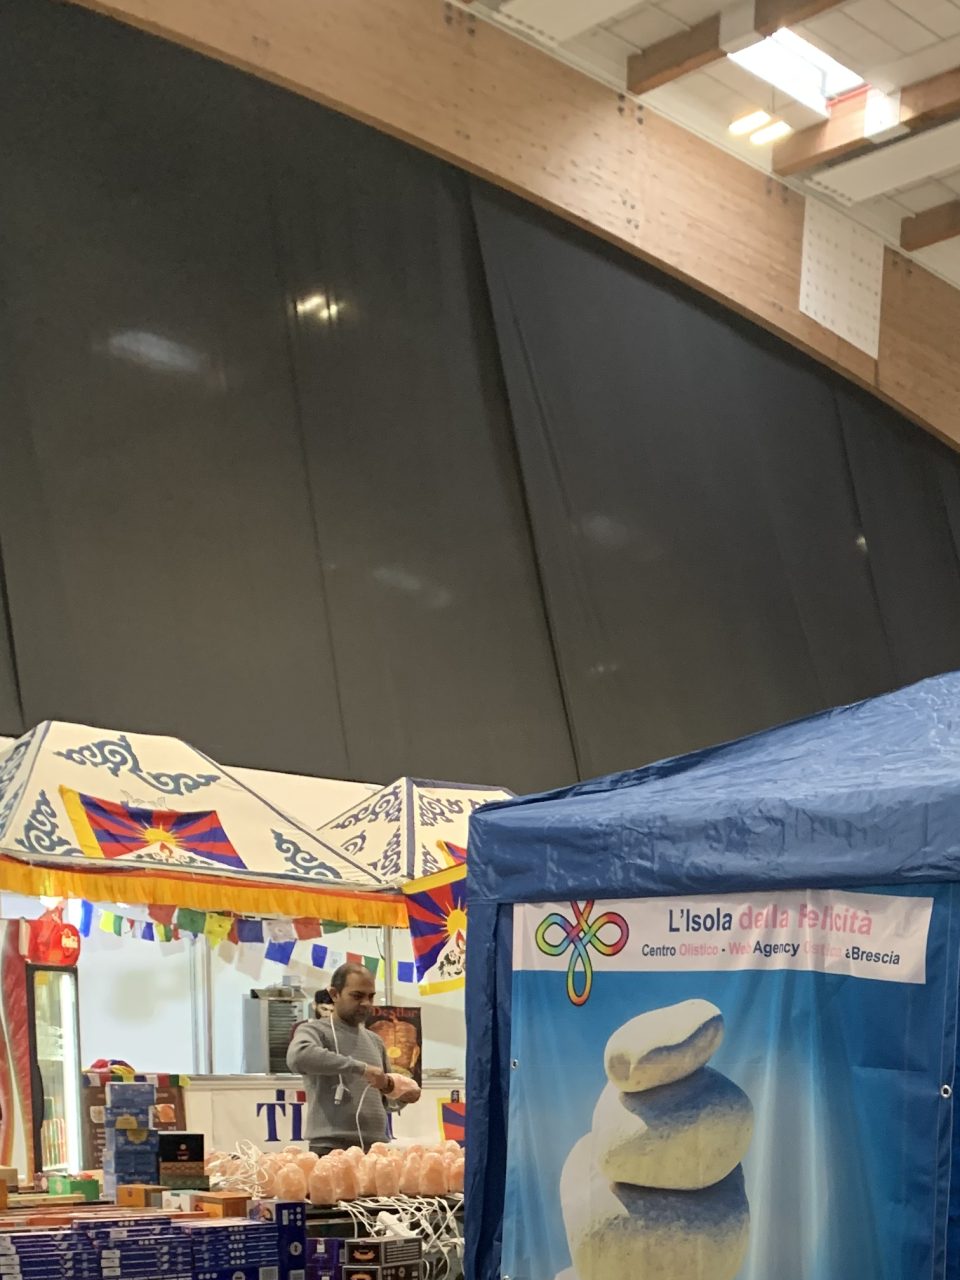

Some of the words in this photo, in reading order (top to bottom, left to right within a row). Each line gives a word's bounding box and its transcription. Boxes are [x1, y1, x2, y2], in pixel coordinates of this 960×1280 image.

[668, 906, 733, 933] L'Isola
[738, 903, 789, 931] della
[641, 943, 677, 957] Centro
[679, 943, 719, 957] Olistico
[752, 940, 800, 958] Agency
[851, 946, 901, 966] Brescia
